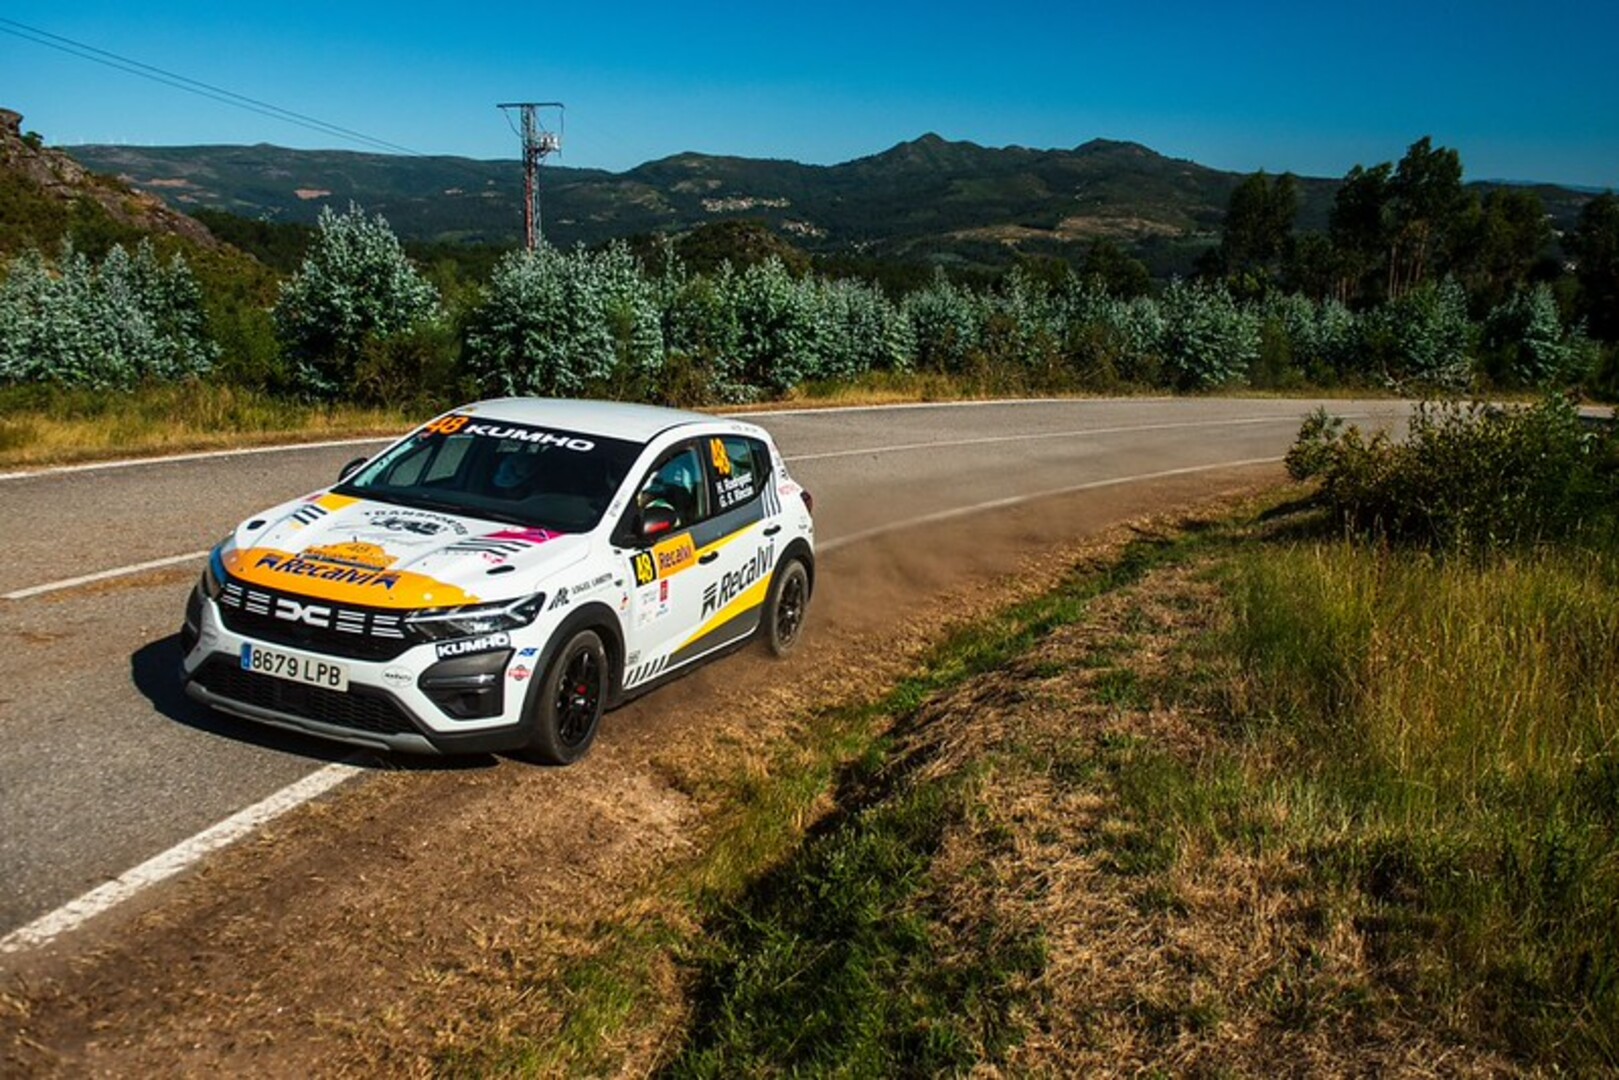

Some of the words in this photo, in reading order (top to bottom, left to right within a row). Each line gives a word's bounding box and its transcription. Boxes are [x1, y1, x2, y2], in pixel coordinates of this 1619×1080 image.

[427, 416, 469, 434] 48
[464, 424, 595, 451] KUMHO
[276, 556, 376, 586] Recalvi
[635, 553, 654, 585] 48
[717, 538, 775, 608] Recalvi
[437, 633, 510, 658] KUMHO
[252, 649, 299, 676] 8679
[303, 661, 342, 687] LPB
